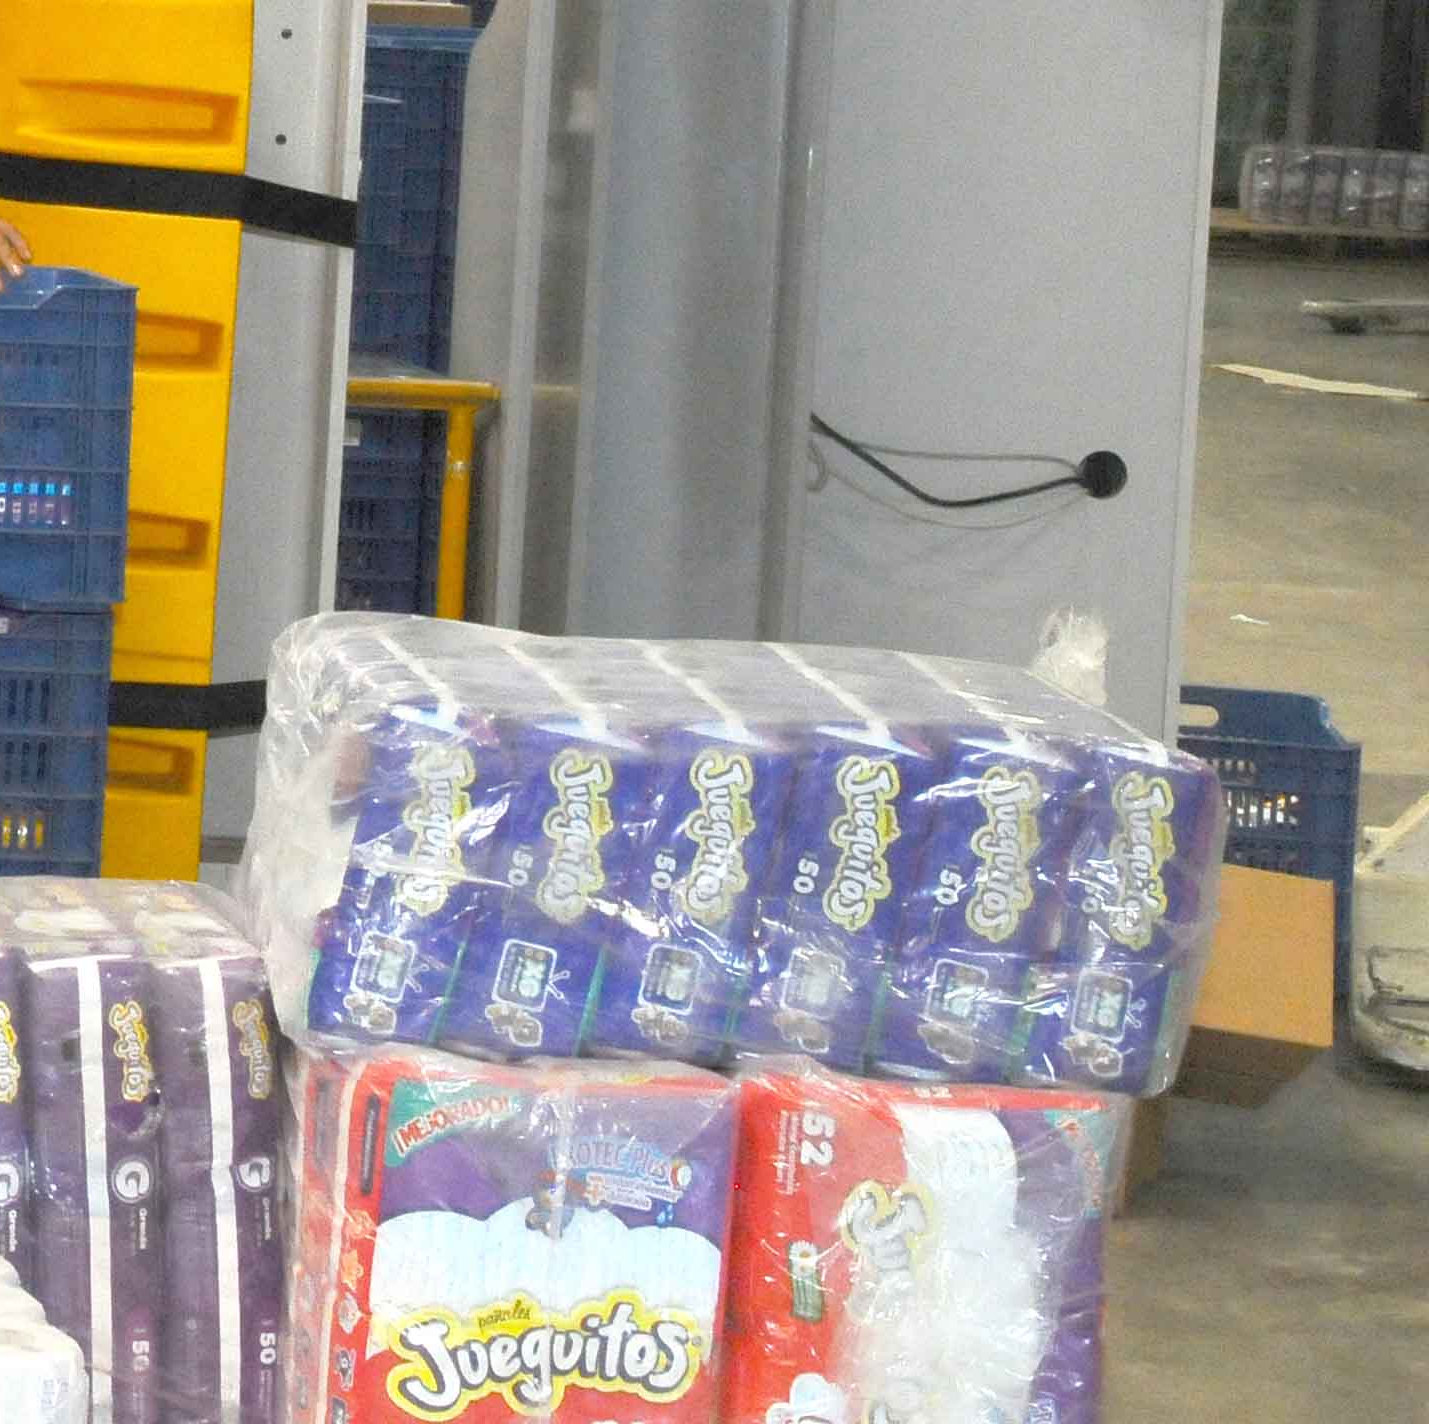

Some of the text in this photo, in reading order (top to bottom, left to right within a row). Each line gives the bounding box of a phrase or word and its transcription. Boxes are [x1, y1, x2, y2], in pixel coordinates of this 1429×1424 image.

[826, 759, 894, 923] Jueguitos
[651, 852, 677, 891] 50
[793, 858, 820, 894] 50
[259, 1332, 276, 1365] 50
[398, 1302, 691, 1412] Jueguitos
